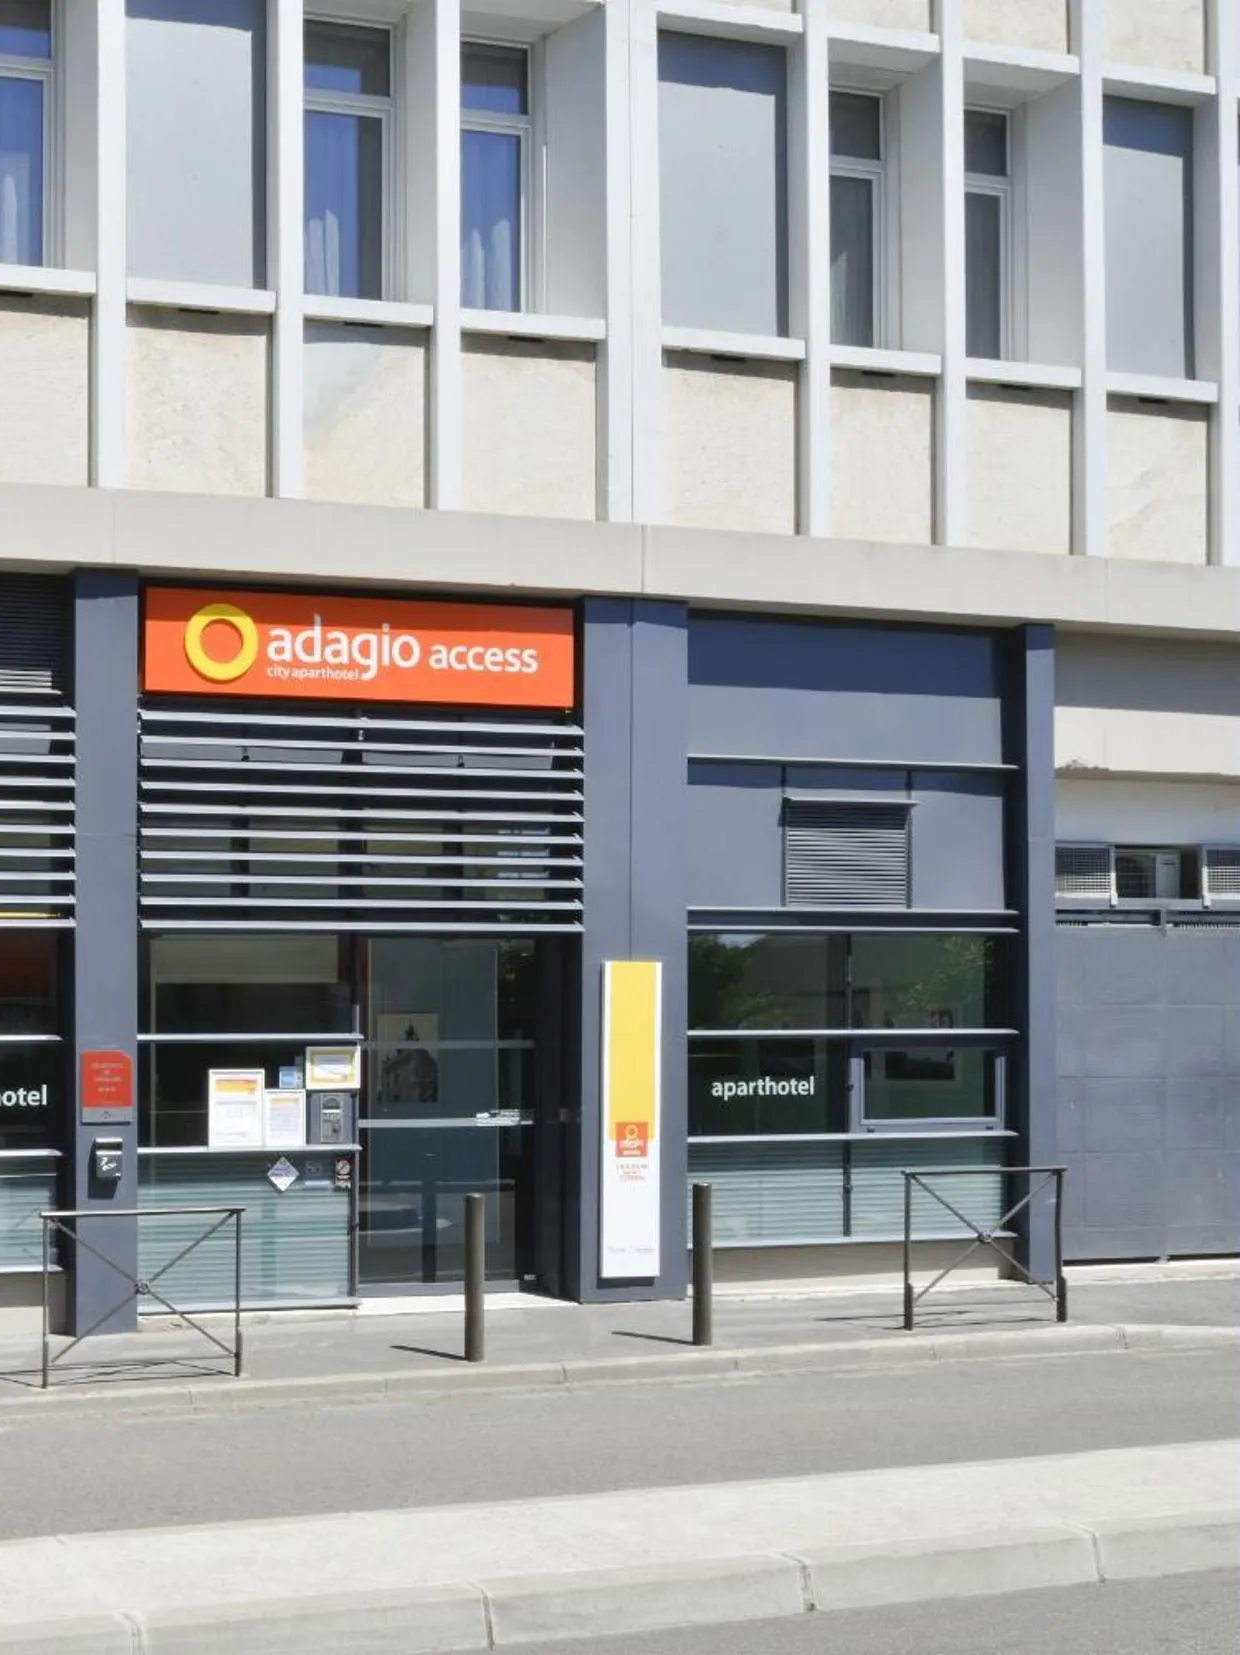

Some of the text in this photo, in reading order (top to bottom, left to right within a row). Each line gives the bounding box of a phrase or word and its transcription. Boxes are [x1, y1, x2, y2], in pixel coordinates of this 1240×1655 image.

[266, 612, 539, 681] adagio access
[266, 665, 359, 682] city aparthotel
[711, 1075, 815, 1101] aparthotel
